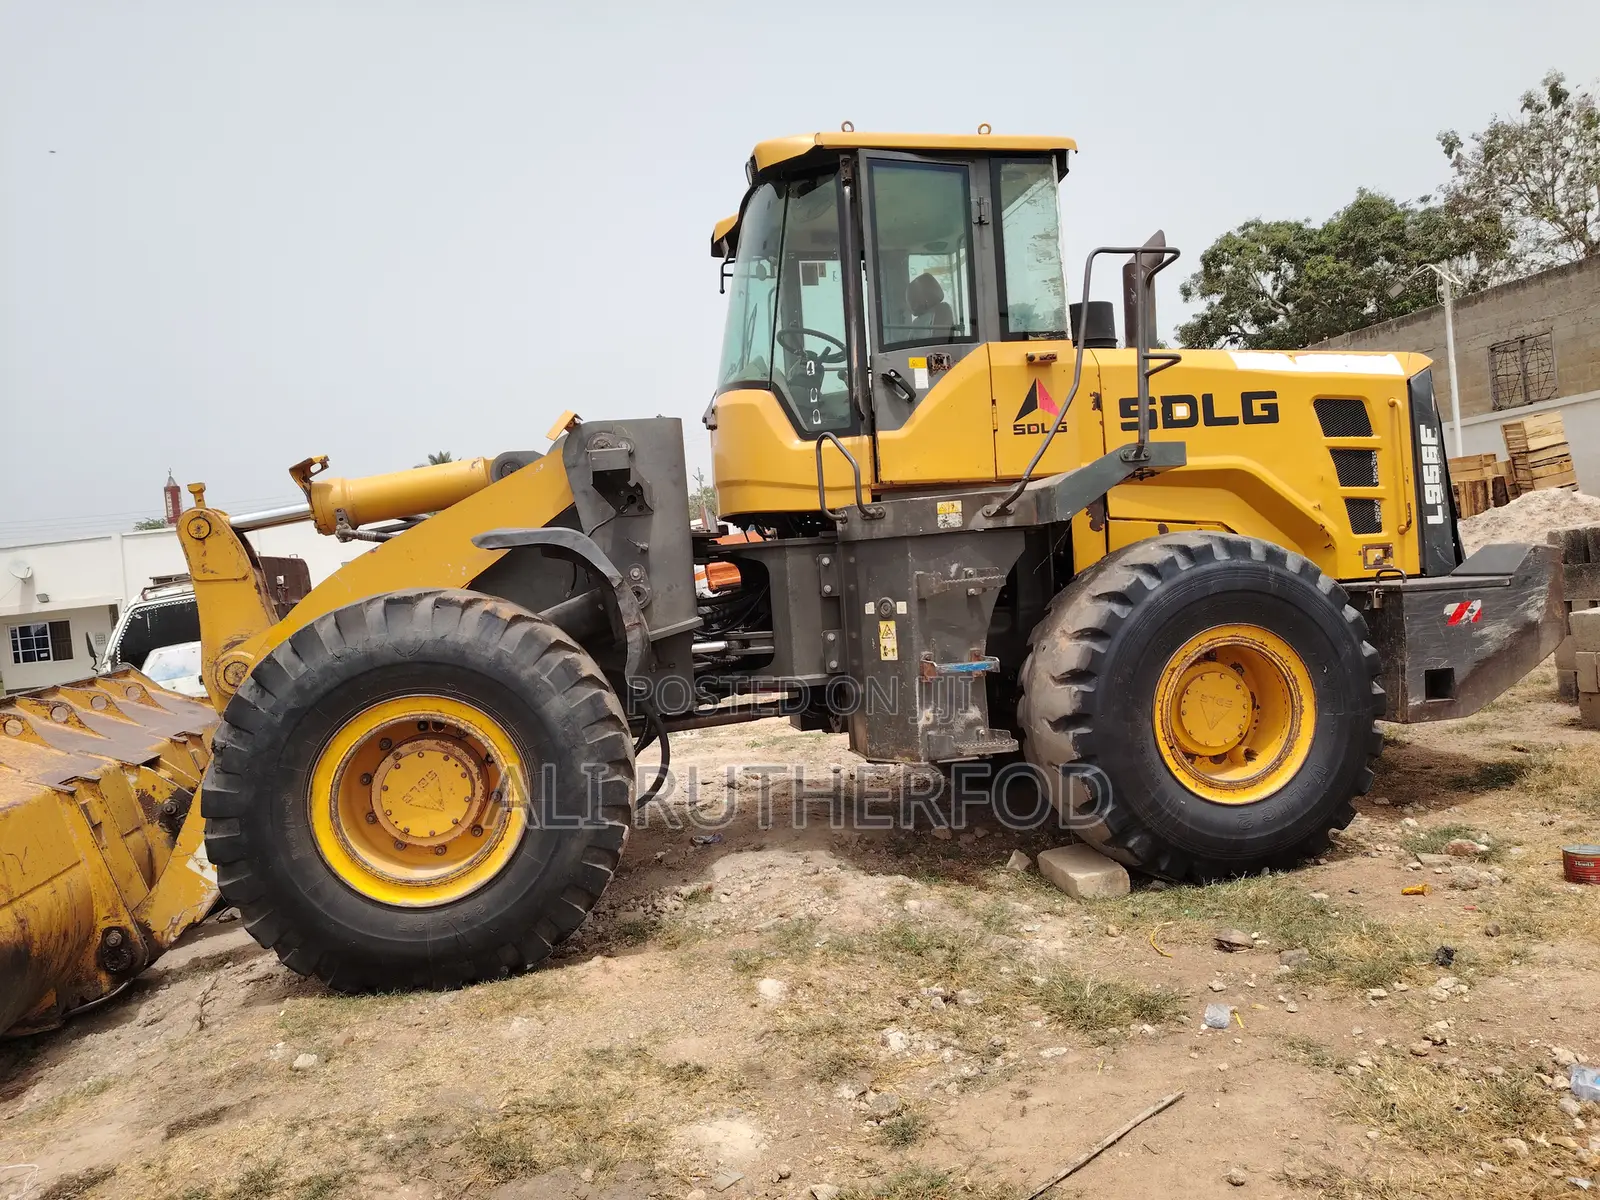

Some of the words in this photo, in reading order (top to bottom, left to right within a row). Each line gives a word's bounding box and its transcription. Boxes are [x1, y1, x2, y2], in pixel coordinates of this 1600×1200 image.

[1012, 420, 1068, 436] SDLG
[1118, 390, 1280, 431] SDLG
[1419, 424, 1444, 525] L956F
